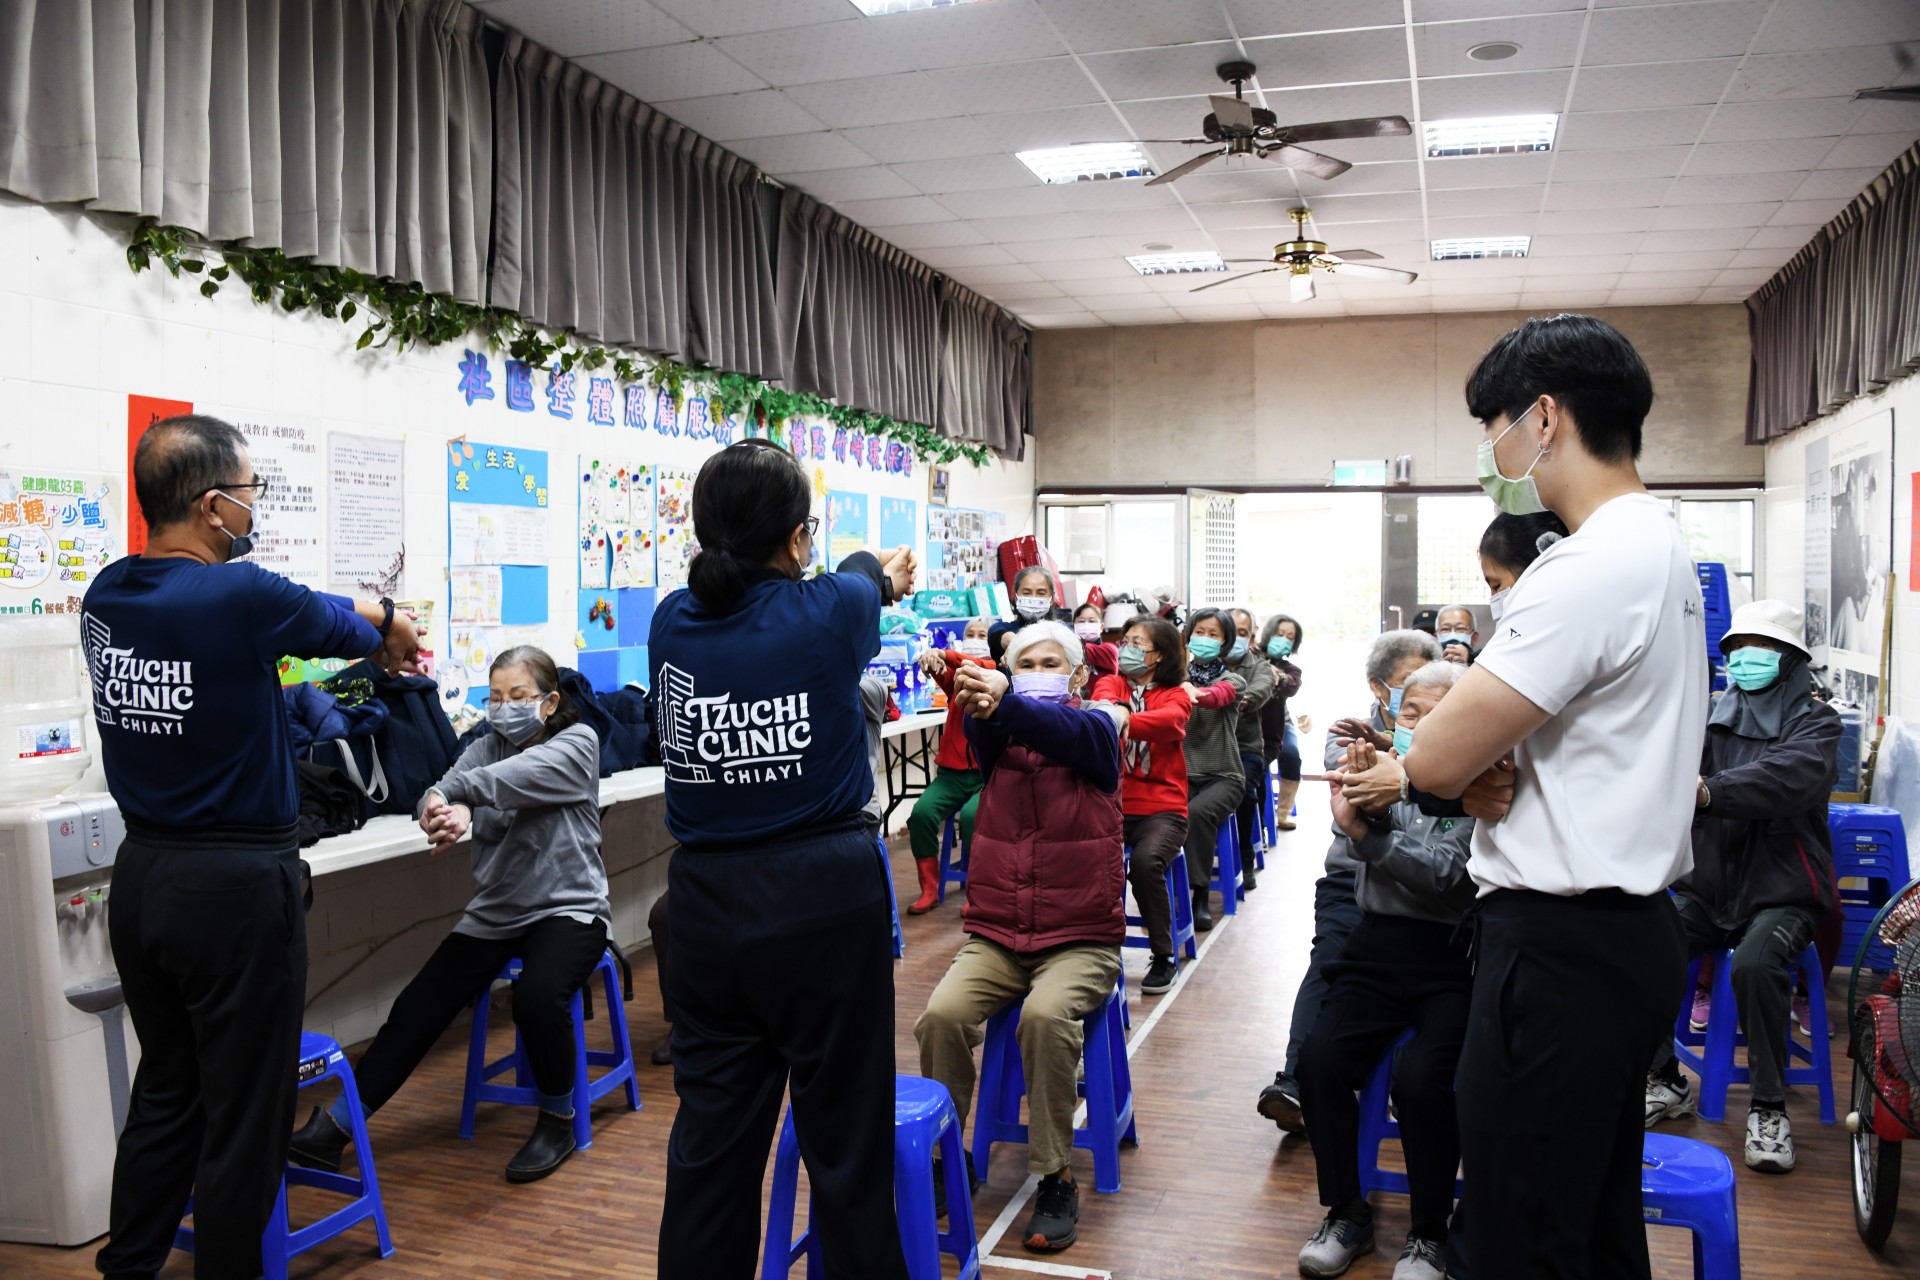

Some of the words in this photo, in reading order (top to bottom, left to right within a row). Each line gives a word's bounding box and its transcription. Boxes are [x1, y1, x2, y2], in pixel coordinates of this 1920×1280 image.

[22, 476, 84, 494] 健康龍好嘉
[455, 470, 470, 492] 愛
[486, 449, 516, 469] 生活
[523, 474, 547, 506] 學習
[101, 646, 193, 684] TZUCHI
[105, 678, 194, 711] CLINIC
[684, 691, 810, 731] TZUCHI
[121, 717, 183, 735] CHIAYI
[697, 721, 812, 762] CLINIC
[723, 762, 802, 784] CHIAYI
